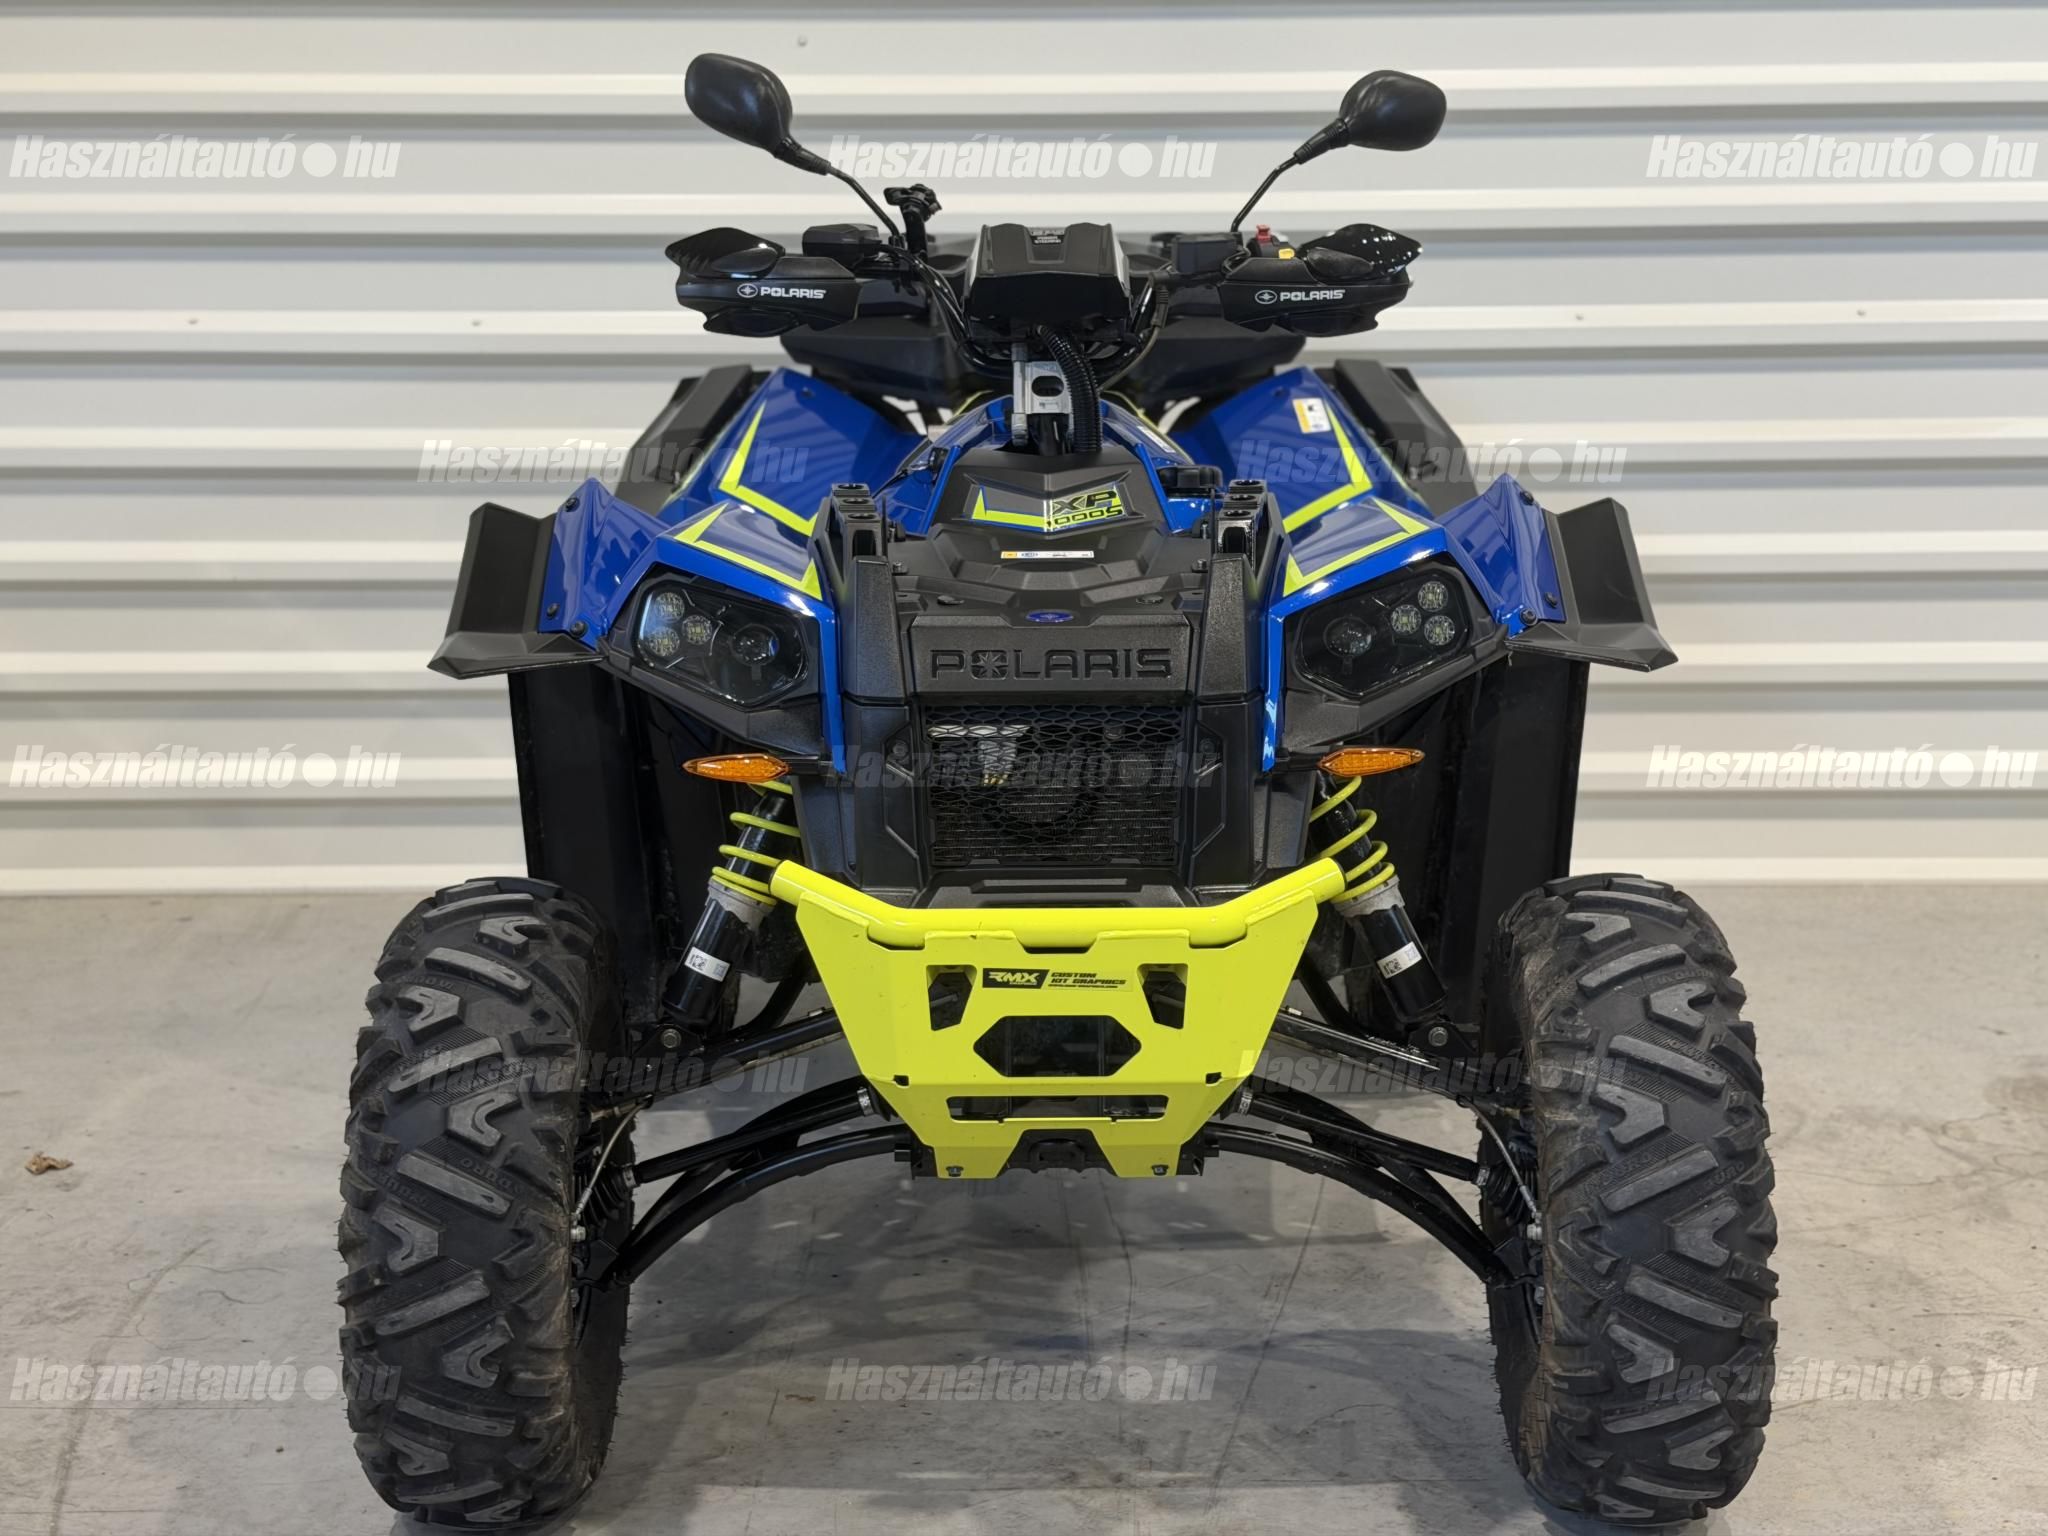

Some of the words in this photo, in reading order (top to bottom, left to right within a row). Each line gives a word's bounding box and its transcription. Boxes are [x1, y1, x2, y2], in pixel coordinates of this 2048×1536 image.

[760, 286, 827, 299] POLARIS
[1279, 289, 1346, 301] POLARIS
[1052, 490, 1117, 515] XP
[930, 649, 1172, 680] POLARIS
